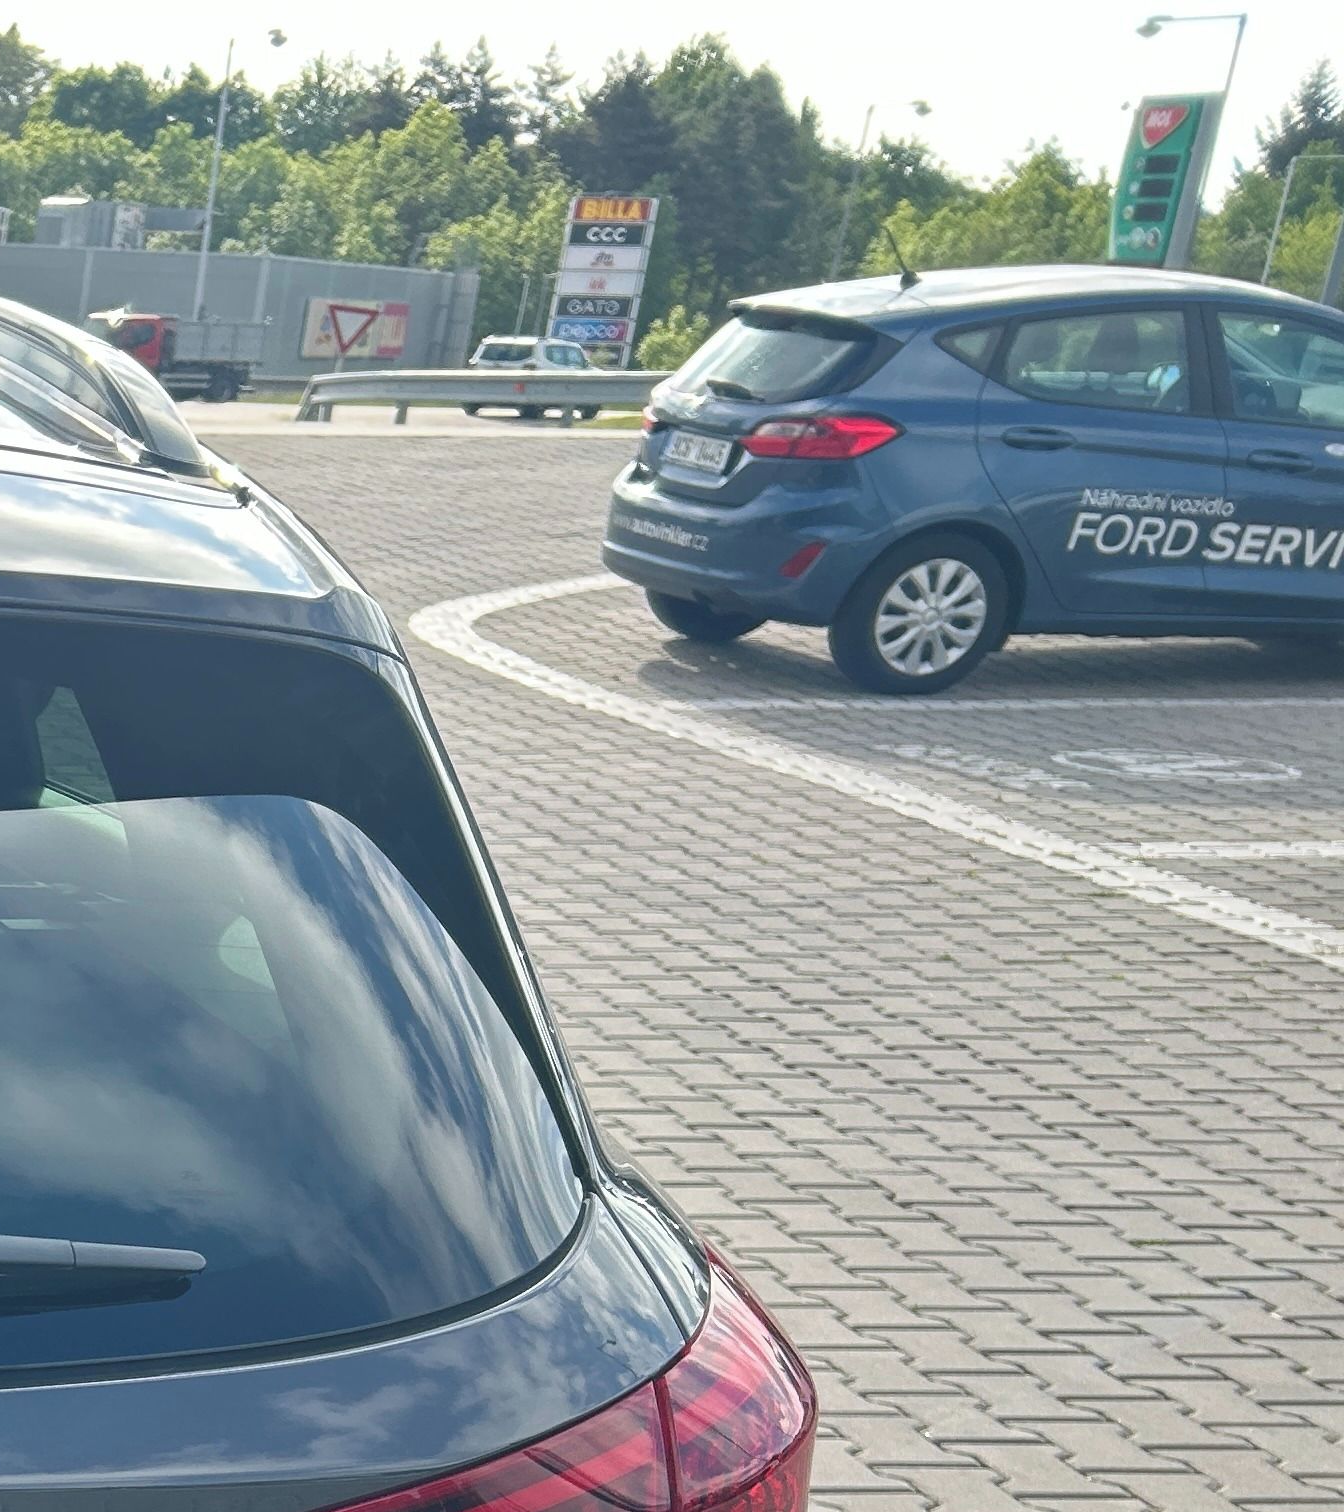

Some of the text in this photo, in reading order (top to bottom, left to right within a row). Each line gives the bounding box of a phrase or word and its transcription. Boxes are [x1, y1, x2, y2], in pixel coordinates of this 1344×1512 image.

[581, 199, 642, 219] BILLA
[586, 226, 628, 243] CCC
[1080, 488, 1236, 518] Náhradní vozidlo
[1066, 512, 1344, 569] FORD SERVI
